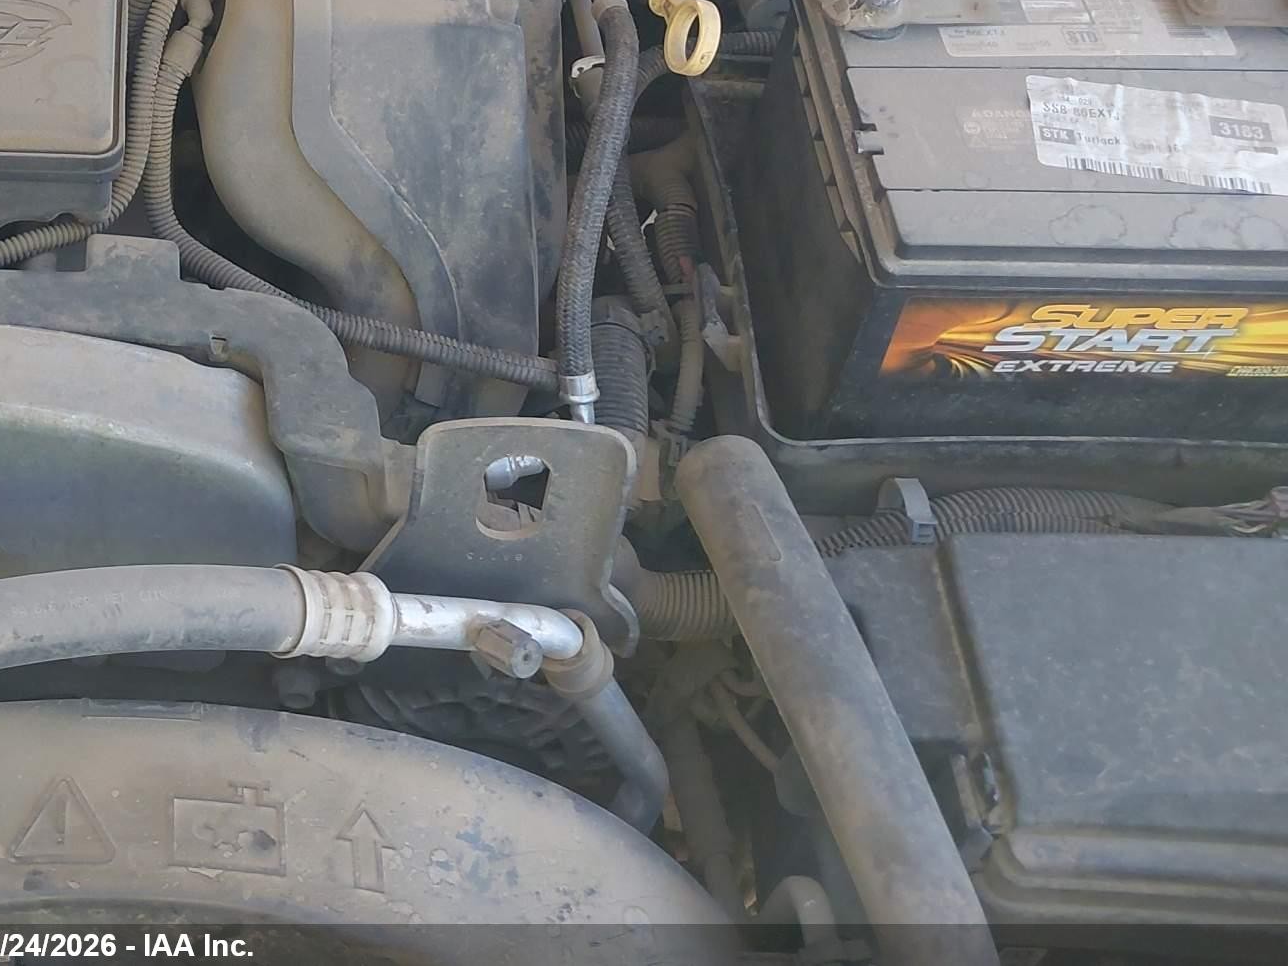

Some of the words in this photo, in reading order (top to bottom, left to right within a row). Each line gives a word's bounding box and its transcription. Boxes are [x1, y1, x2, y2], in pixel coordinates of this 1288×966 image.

[1042, 128, 1069, 140] STK
[1218, 121, 1264, 140] 3183
[1028, 304, 1249, 329] SUPER
[982, 326, 1239, 354] START
[992, 360, 1179, 374] EXTREME
